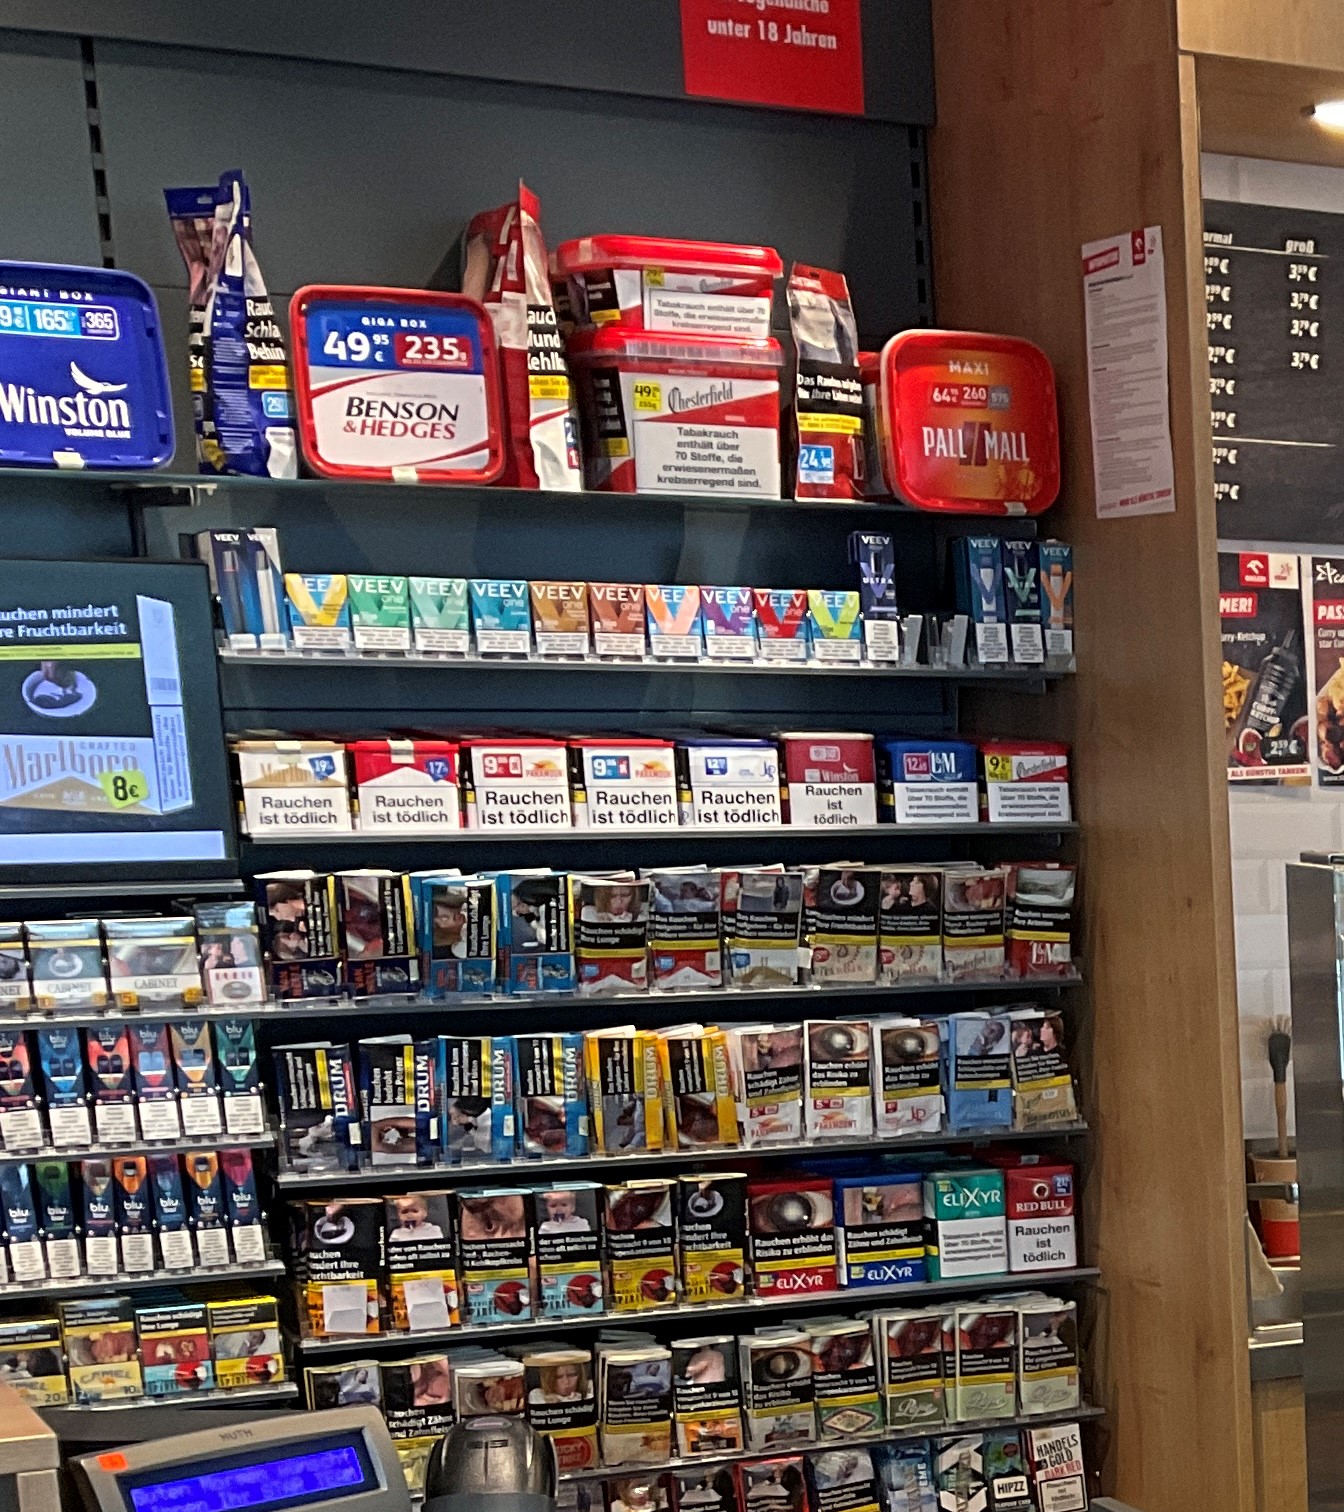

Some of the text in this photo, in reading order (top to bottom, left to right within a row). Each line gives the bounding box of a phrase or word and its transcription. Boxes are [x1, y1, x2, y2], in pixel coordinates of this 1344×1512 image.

[707, 18, 837, 51] unter 18 Jahren
[361, 316, 427, 328] GIGA BOX
[948, 360, 990, 375] MAXI
[0, 382, 130, 428] Winston
[668, 381, 733, 414] Chesterfield
[345, 397, 459, 422] BENSON
[344, 417, 456, 440] &HEDGES
[677, 426, 739, 439] Tabakrauch
[677, 439, 739, 451] enthält über
[922, 426, 1031, 462] PALL MALL
[675, 451, 743, 463] 70 Stoffe, die
[657, 474, 761, 488] krebserregend sind.
[349, 578, 404, 594] VEEV
[0, 604, 118, 622] uchen mindert
[17, 620, 128, 638] Fruchtbarkeit
[1318, 628, 1336, 638] Curry
[2, 738, 141, 790] Marlboro
[1231, 769, 1243, 777] ALS
[113, 775, 140, 802] 8€
[805, 784, 863, 798] Rauchen
[261, 795, 333, 809] Rauchen
[375, 794, 443, 808] Rauchen
[485, 790, 564, 807] Rauchen
[596, 791, 673, 807] Rauchen
[701, 790, 775, 806] Rauchen
[827, 798, 842, 811] ist
[259, 809, 338, 825] ist tödlich
[372, 808, 449, 824] ist tödlich
[481, 808, 568, 825] ist tödlich
[814, 811, 858, 826] tödlich
[133, 976, 179, 991] CABINET
[334, 1058, 349, 1117] DRUM
[416, 1054, 430, 1113] DRUM
[1015, 1198, 1067, 1212] RED BULL
[1023, 1249, 1066, 1263] tödlich
[776, 1272, 824, 1290] ELIXYR
[1037, 1432, 1079, 1458] HANDELS
[1050, 1448, 1073, 1466] GOLD
[997, 1481, 1026, 1495] HIPZZ
